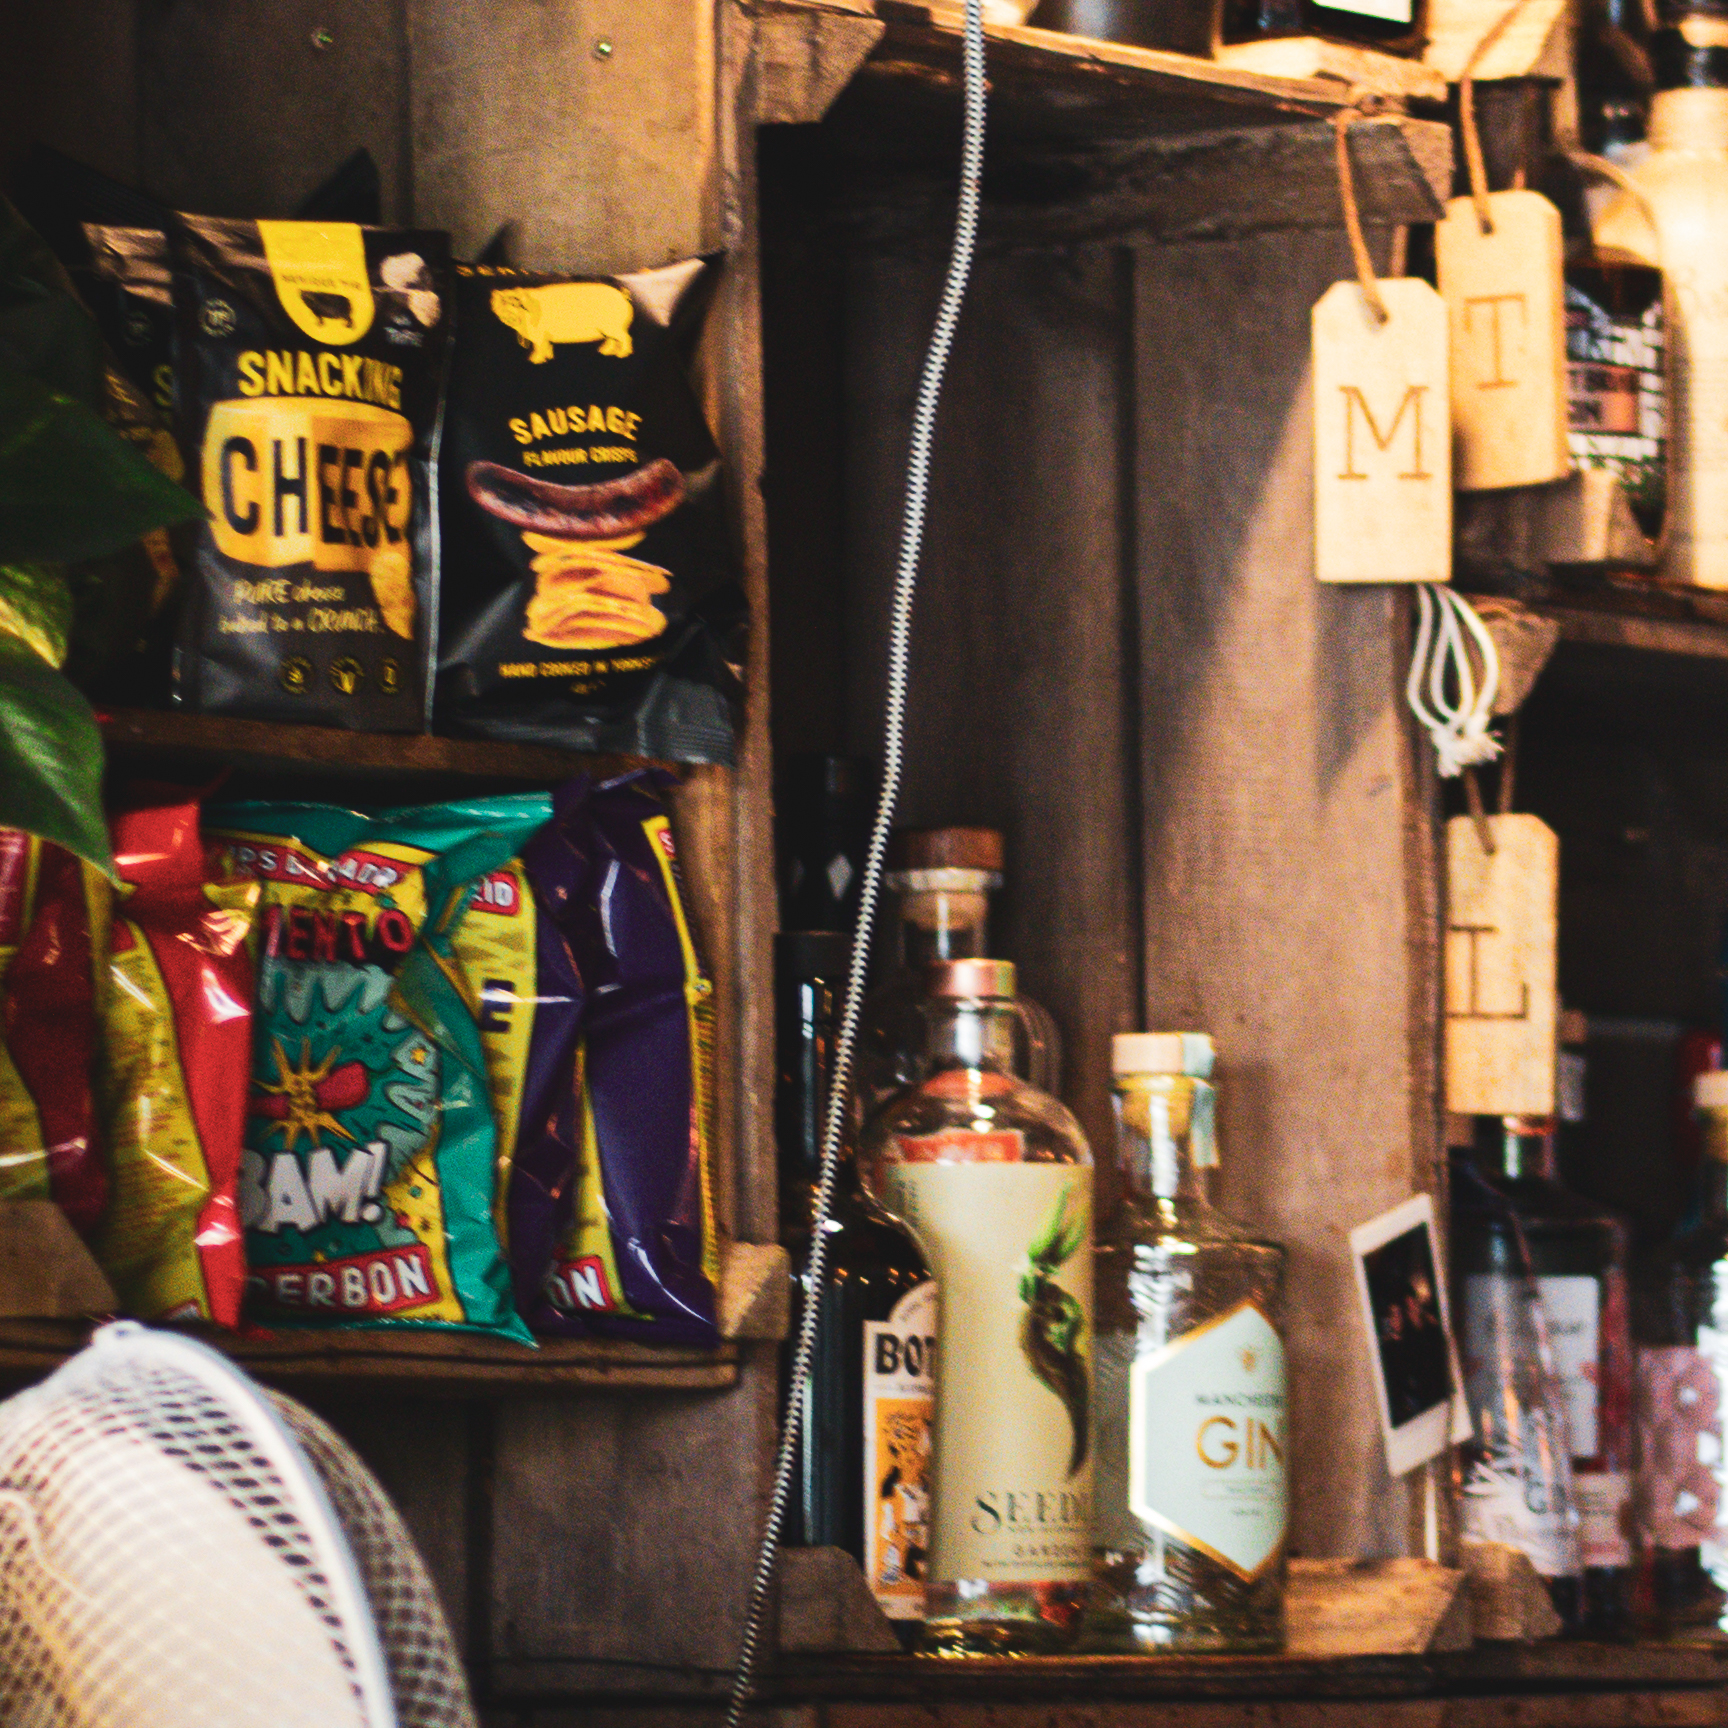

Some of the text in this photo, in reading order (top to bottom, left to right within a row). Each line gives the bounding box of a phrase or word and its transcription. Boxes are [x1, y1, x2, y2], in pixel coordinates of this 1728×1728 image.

[237, 349, 403, 411] SNACKING
[1464, 294, 1529, 391] T
[508, 404, 643, 446] SAUSAGE
[1338, 385, 1432, 481] M
[220, 435, 406, 548] CHEESE
[1445, 923, 1531, 1022] L
[1196, 1415, 1287, 1470] GIN
